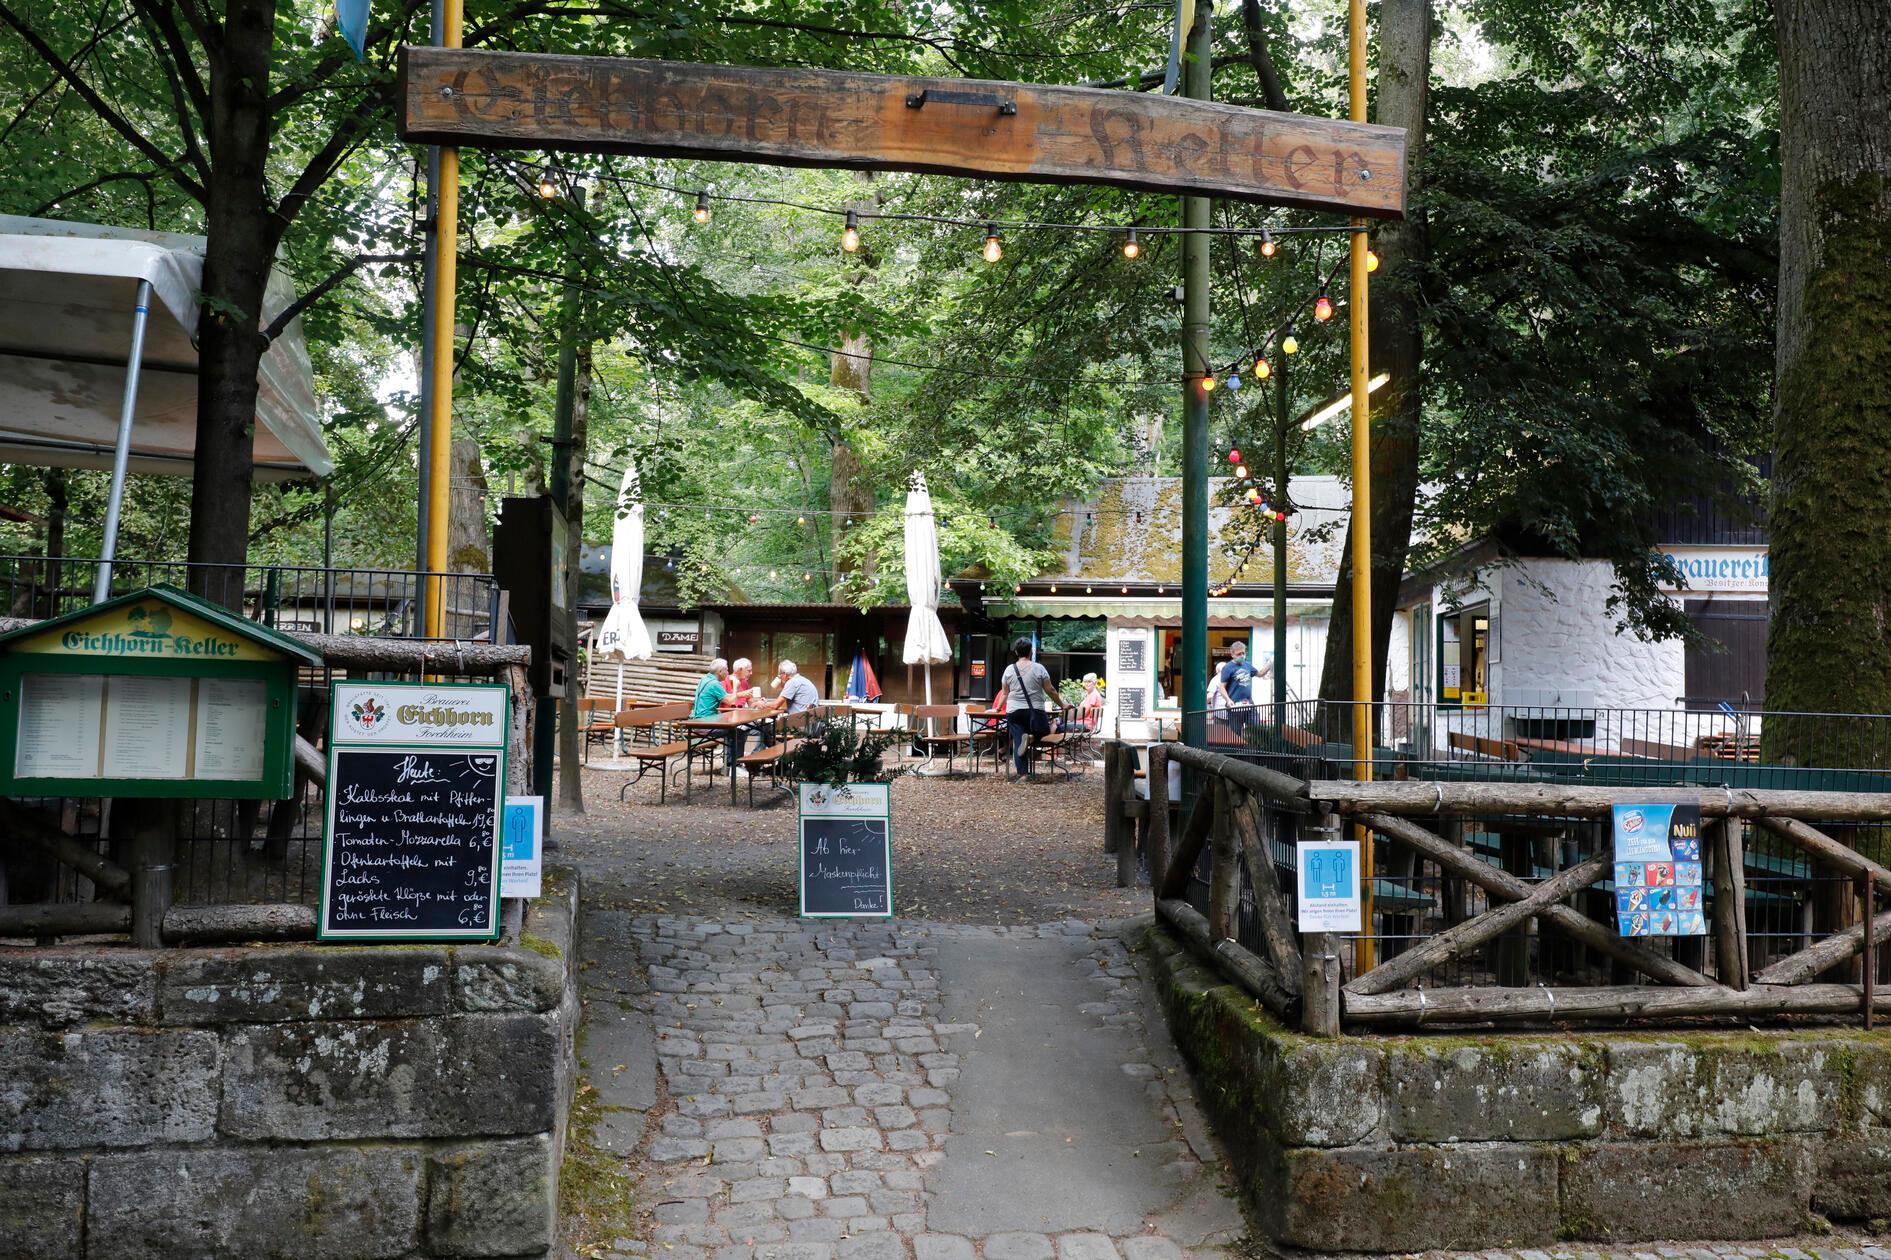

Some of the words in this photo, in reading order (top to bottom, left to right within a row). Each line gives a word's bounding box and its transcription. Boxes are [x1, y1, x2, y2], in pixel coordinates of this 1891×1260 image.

[451, 62, 838, 145] Eichhorn
[1090, 100, 1371, 197] Keller
[1650, 553, 1760, 579] rauerei
[1704, 579, 1745, 588] Besitzer
[273, 623, 313, 632] ERREN
[62, 631, 239, 657] Eichhorn-Keller
[661, 632, 699, 642] DAME
[421, 693, 473, 706] Brauerei
[396, 704, 495, 727] Eichhorn
[416, 726, 473, 739] Forchheim
[420, 791, 440, 802] mit
[339, 809, 376, 829] lingen
[1673, 823, 1697, 837] Nuii
[810, 837, 830, 856] Ab
[341, 852, 428, 872] Ofenkartoffeln
[434, 857, 457, 867] mit
[335, 869, 381, 887] Lachs
[808, 862, 881, 883] Maskenpflicht
[436, 892, 458, 902] mit
[463, 891, 488, 902] oder
[853, 895, 884, 909] Danke!
[336, 909, 367, 921] ohne
[371, 907, 418, 921] Fleisch
